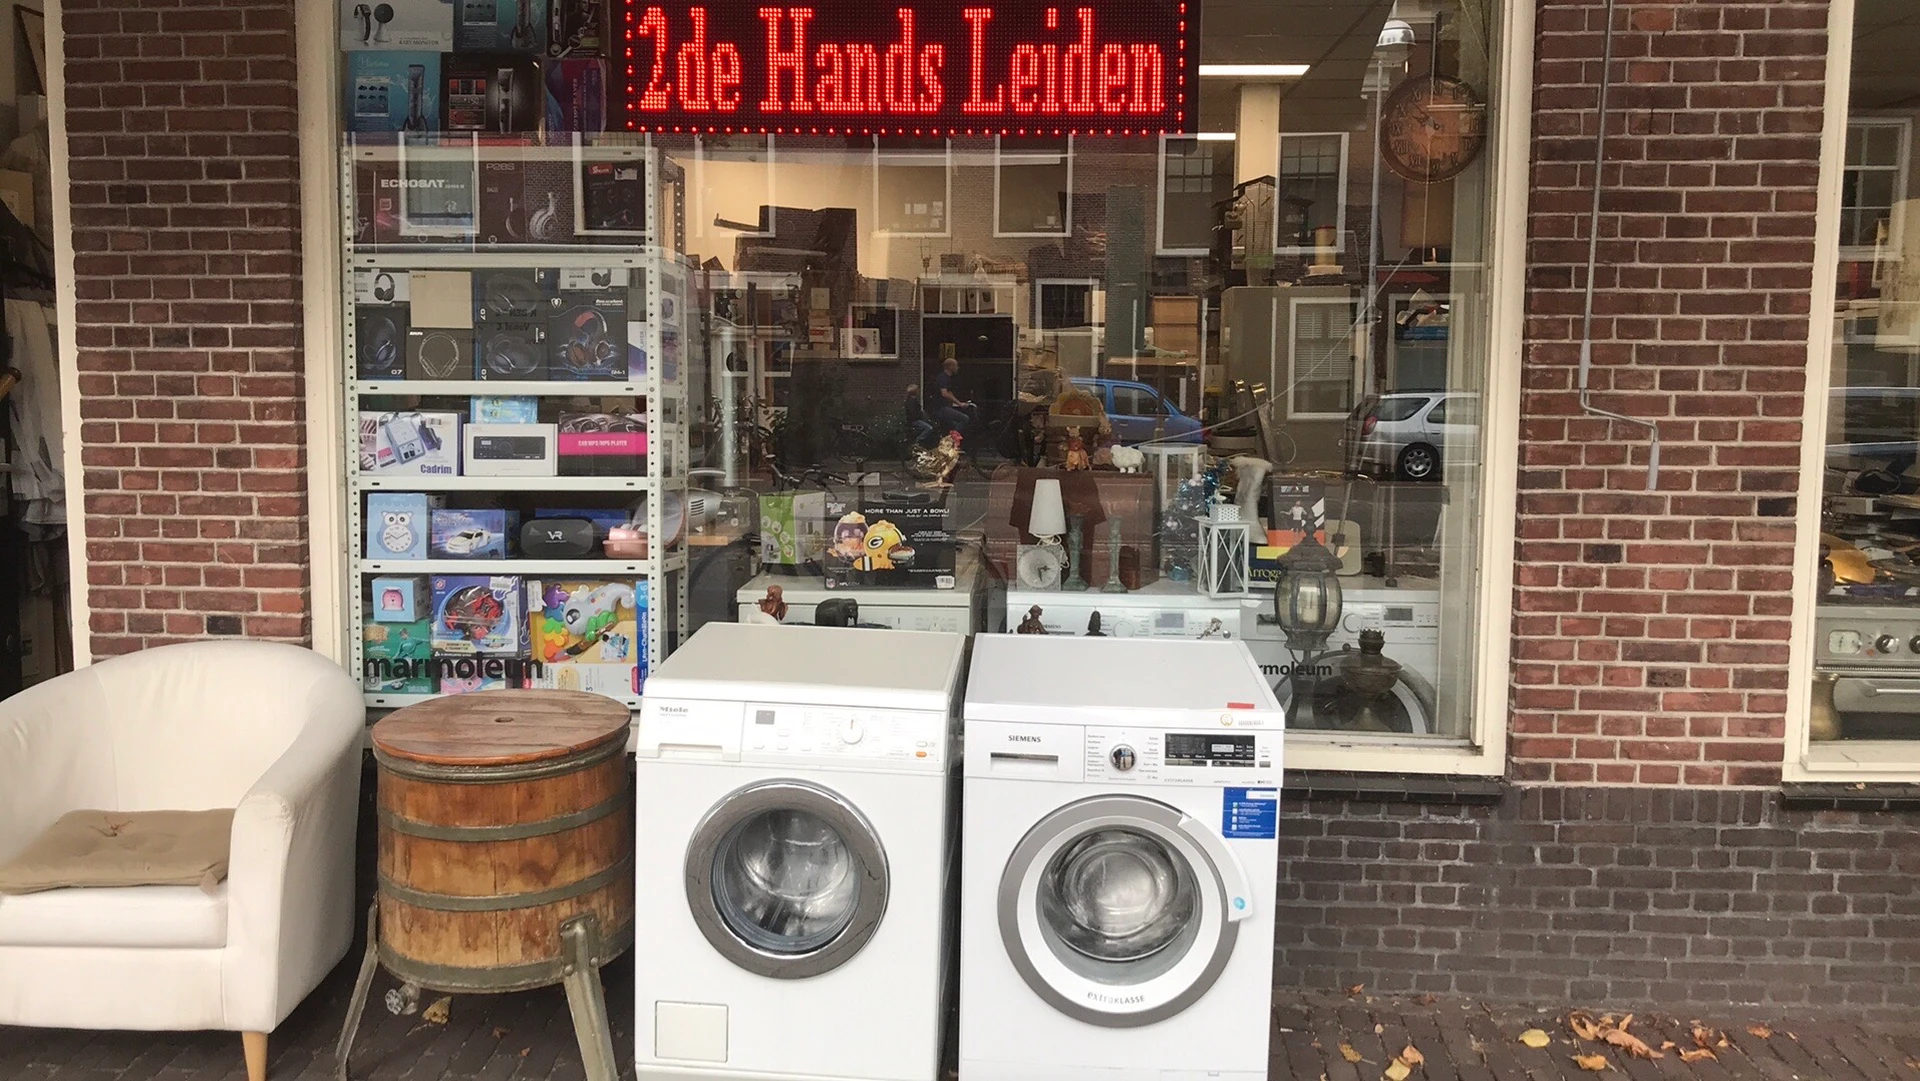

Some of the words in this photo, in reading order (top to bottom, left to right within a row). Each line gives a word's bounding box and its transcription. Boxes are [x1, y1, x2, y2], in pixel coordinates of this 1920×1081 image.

[638, 7, 744, 112] 2de
[759, 7, 945, 113] Hands
[962, 7, 1166, 113] Leiden
[381, 179, 445, 189] ECHOSAT
[420, 464, 452, 474] Cadrim
[547, 530, 563, 540] VR
[1258, 661, 1333, 676] rmoleum
[658, 705, 689, 713] Miele
[1008, 734, 1041, 743] SIEMENS
[1087, 991, 1145, 1004] extraKLASSE
